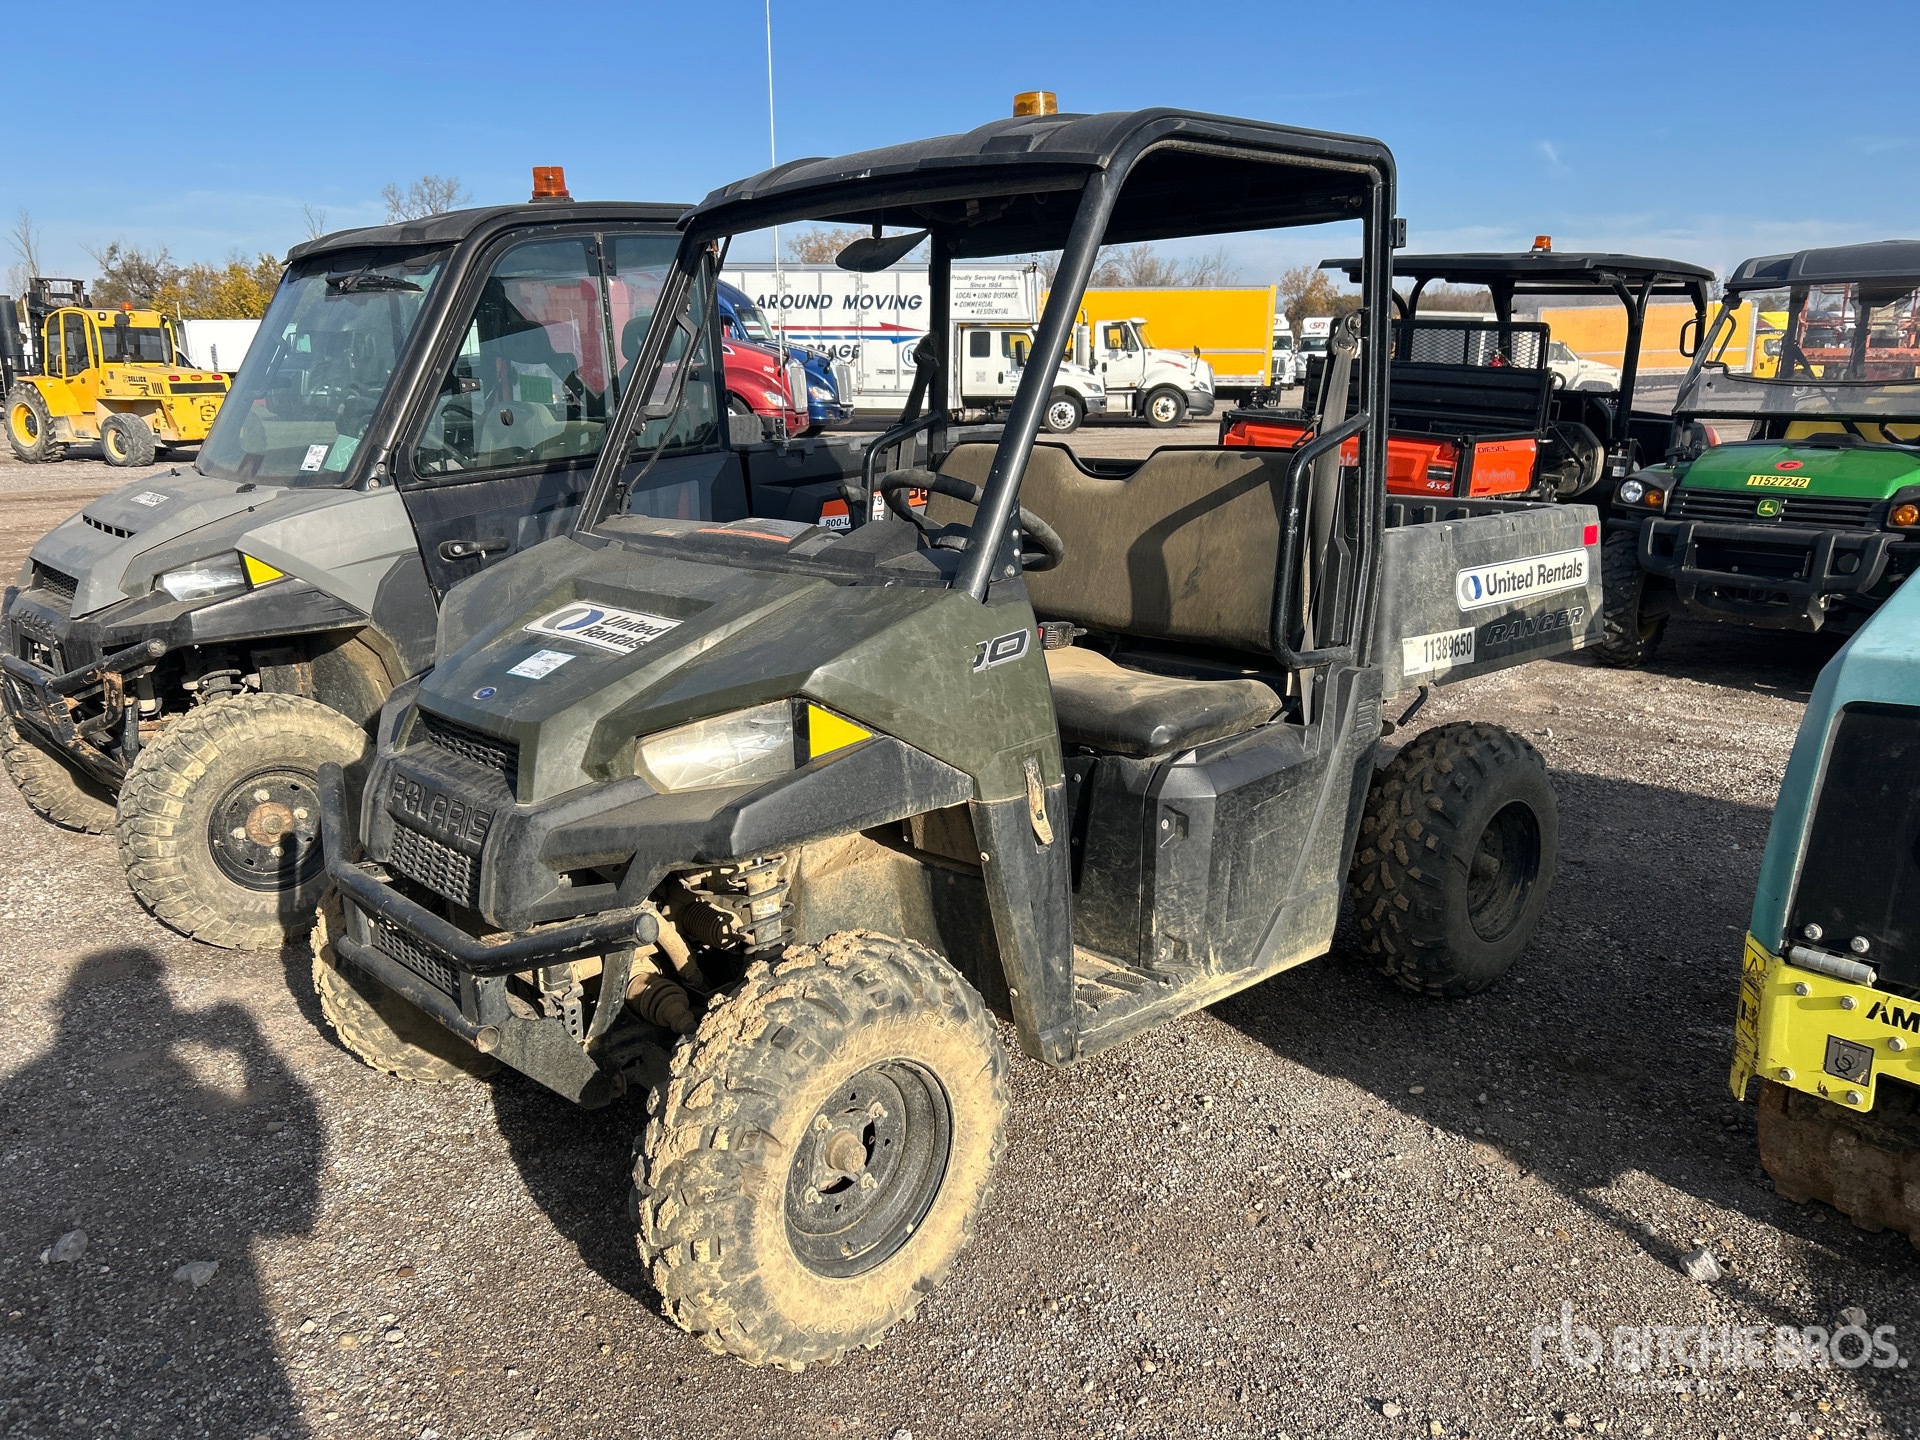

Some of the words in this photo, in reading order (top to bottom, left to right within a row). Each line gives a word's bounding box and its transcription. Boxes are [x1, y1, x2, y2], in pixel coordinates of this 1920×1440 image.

[756, 294, 833, 310] AROUND
[842, 294, 923, 310] MOVING
[1477, 445, 1509, 453] DIESEL
[1426, 481, 1451, 491] 4x4
[1751, 476, 1807, 488] 11527242
[1486, 568, 1534, 596] United
[1537, 557, 1583, 586] Rentals
[576, 625, 648, 649] Rentals
[600, 615, 672, 637] United
[1485, 606, 1585, 646] RANGER
[1423, 631, 1473, 663] 11389650
[388, 772, 491, 847] POLARIS
